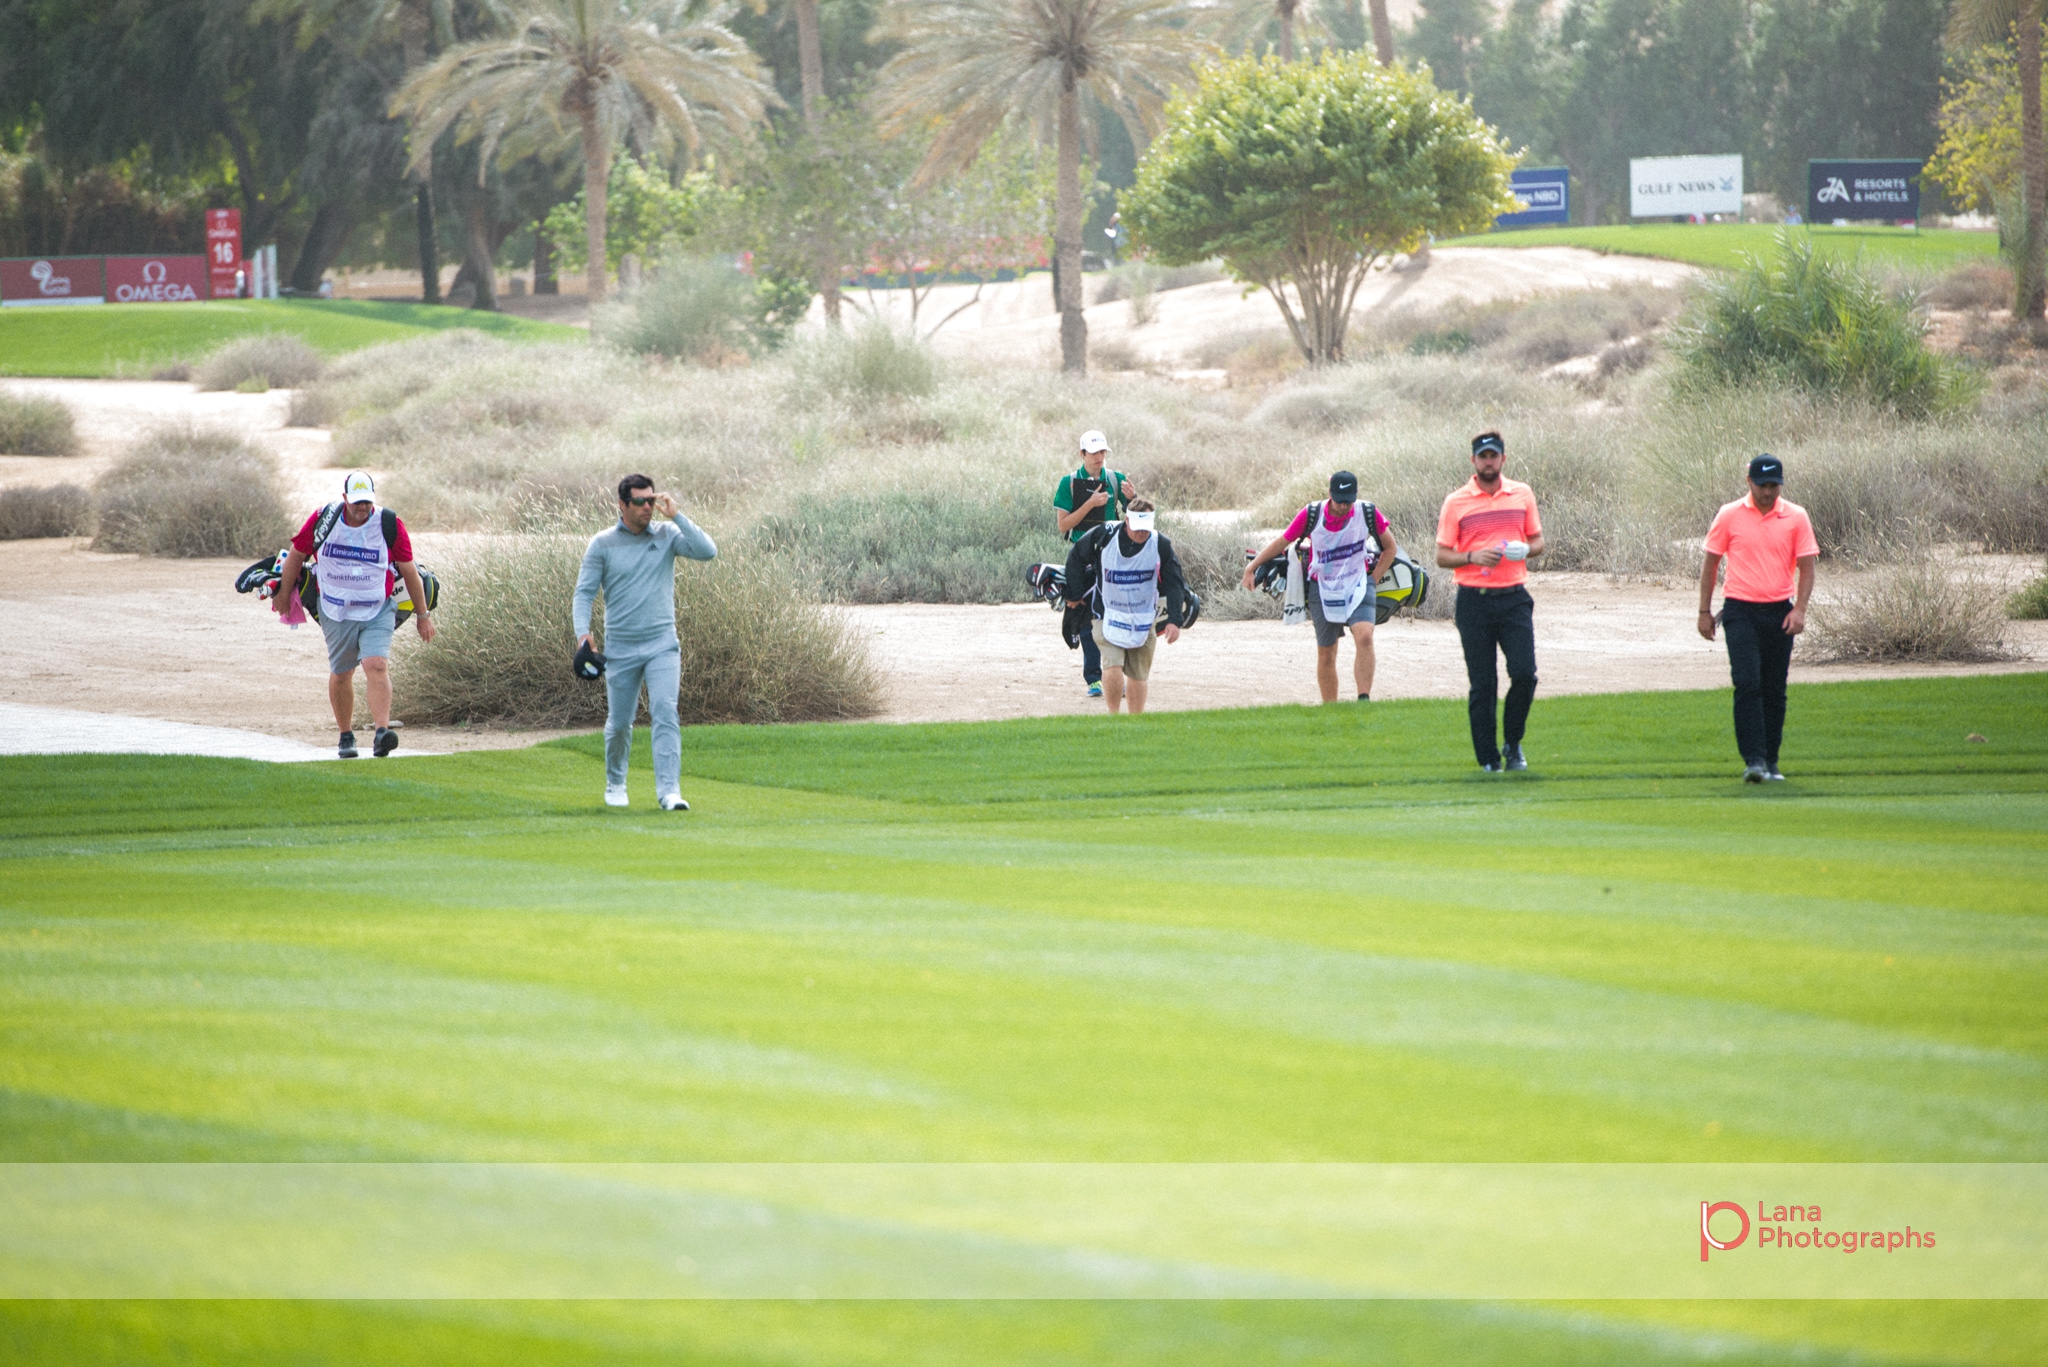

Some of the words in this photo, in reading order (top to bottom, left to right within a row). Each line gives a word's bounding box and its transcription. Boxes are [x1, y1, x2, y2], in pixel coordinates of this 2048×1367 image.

[1638, 182, 1672, 195] GULF
[1678, 181, 1716, 192] NEWS
[1854, 178, 1907, 190] RESORTS
[1534, 190, 1560, 202] NBD
[1853, 191, 1863, 202] &
[1864, 191, 1910, 202] HOTELS
[208, 228, 238, 239] OMEGA
[213, 241, 235, 264] 16
[115, 283, 198, 302] OMEGA
[332, 547, 361, 559] Emirates
[361, 551, 378, 560] NBD
[326, 572, 371, 582] #banktheputt
[1114, 573, 1140, 581] Emirates
